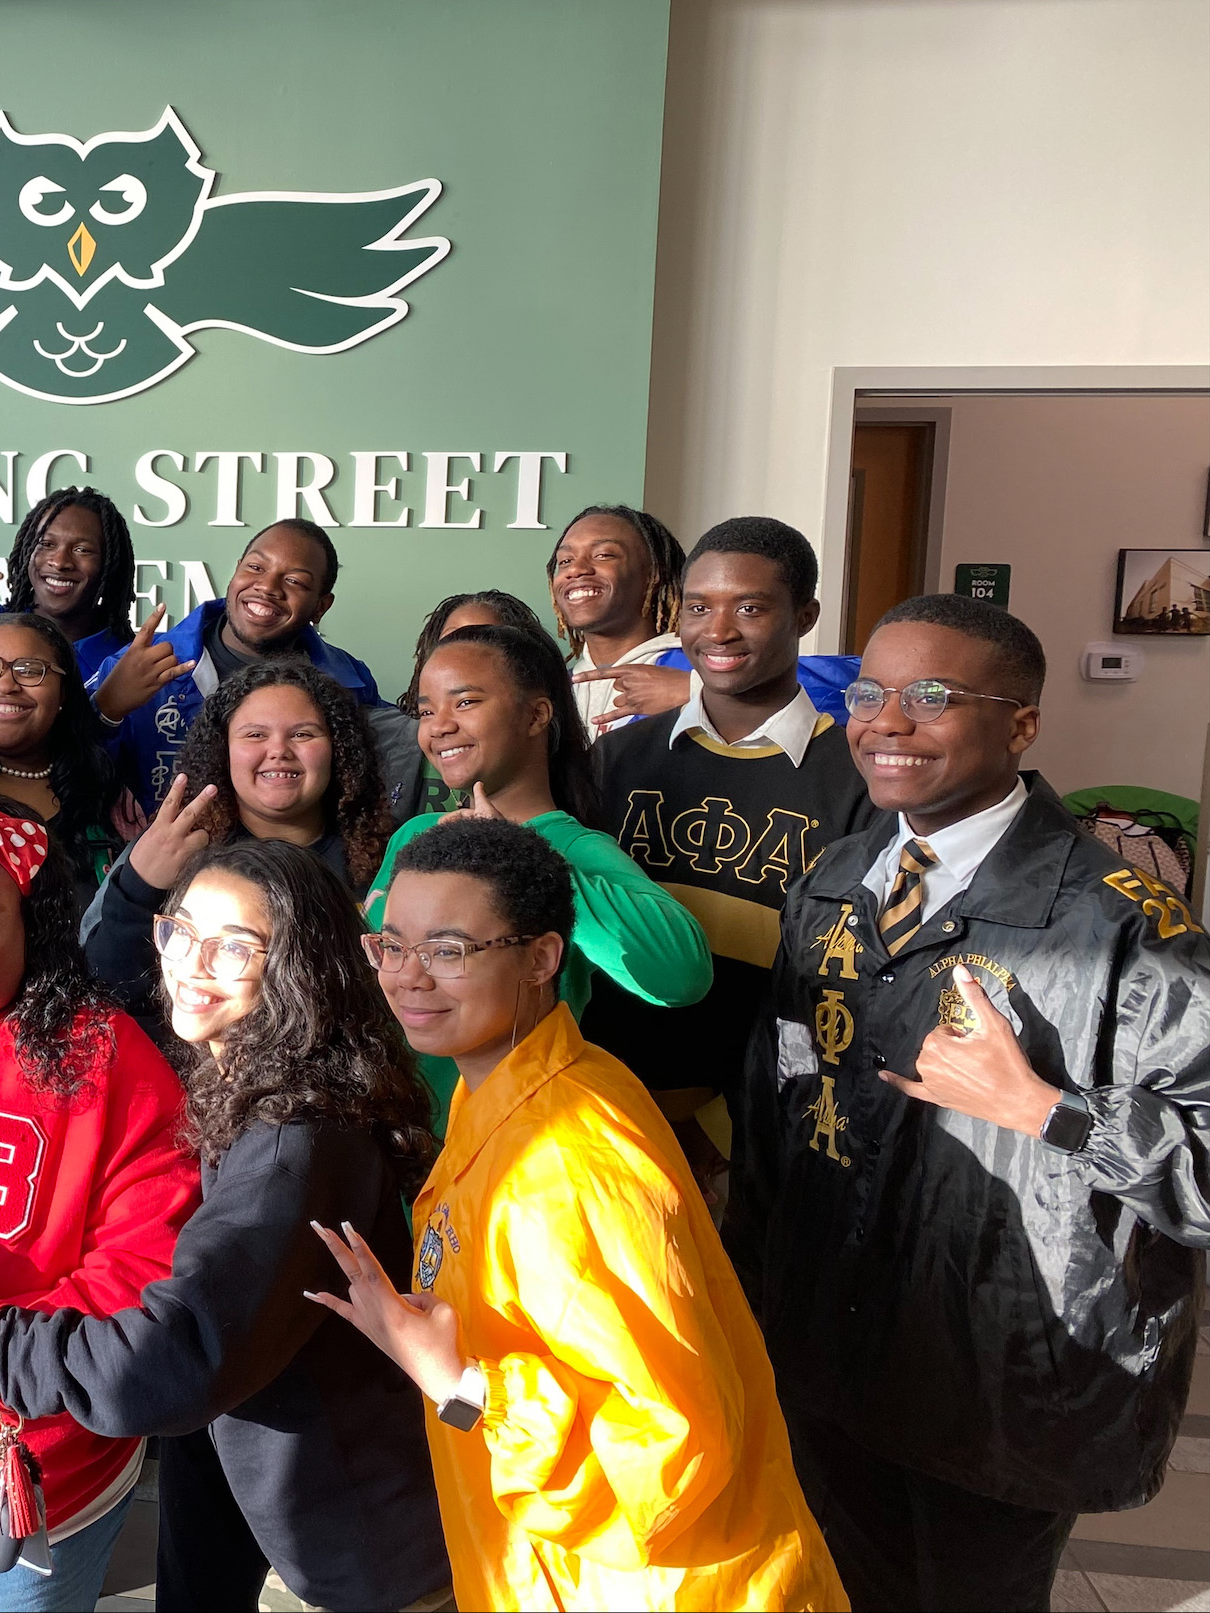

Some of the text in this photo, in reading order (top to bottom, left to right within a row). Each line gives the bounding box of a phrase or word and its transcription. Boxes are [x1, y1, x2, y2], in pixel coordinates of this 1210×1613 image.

[133, 450, 567, 530] STREET
[971, 587, 995, 599] 104
[928, 953, 1018, 993] ALPHA PHI ALPHA
